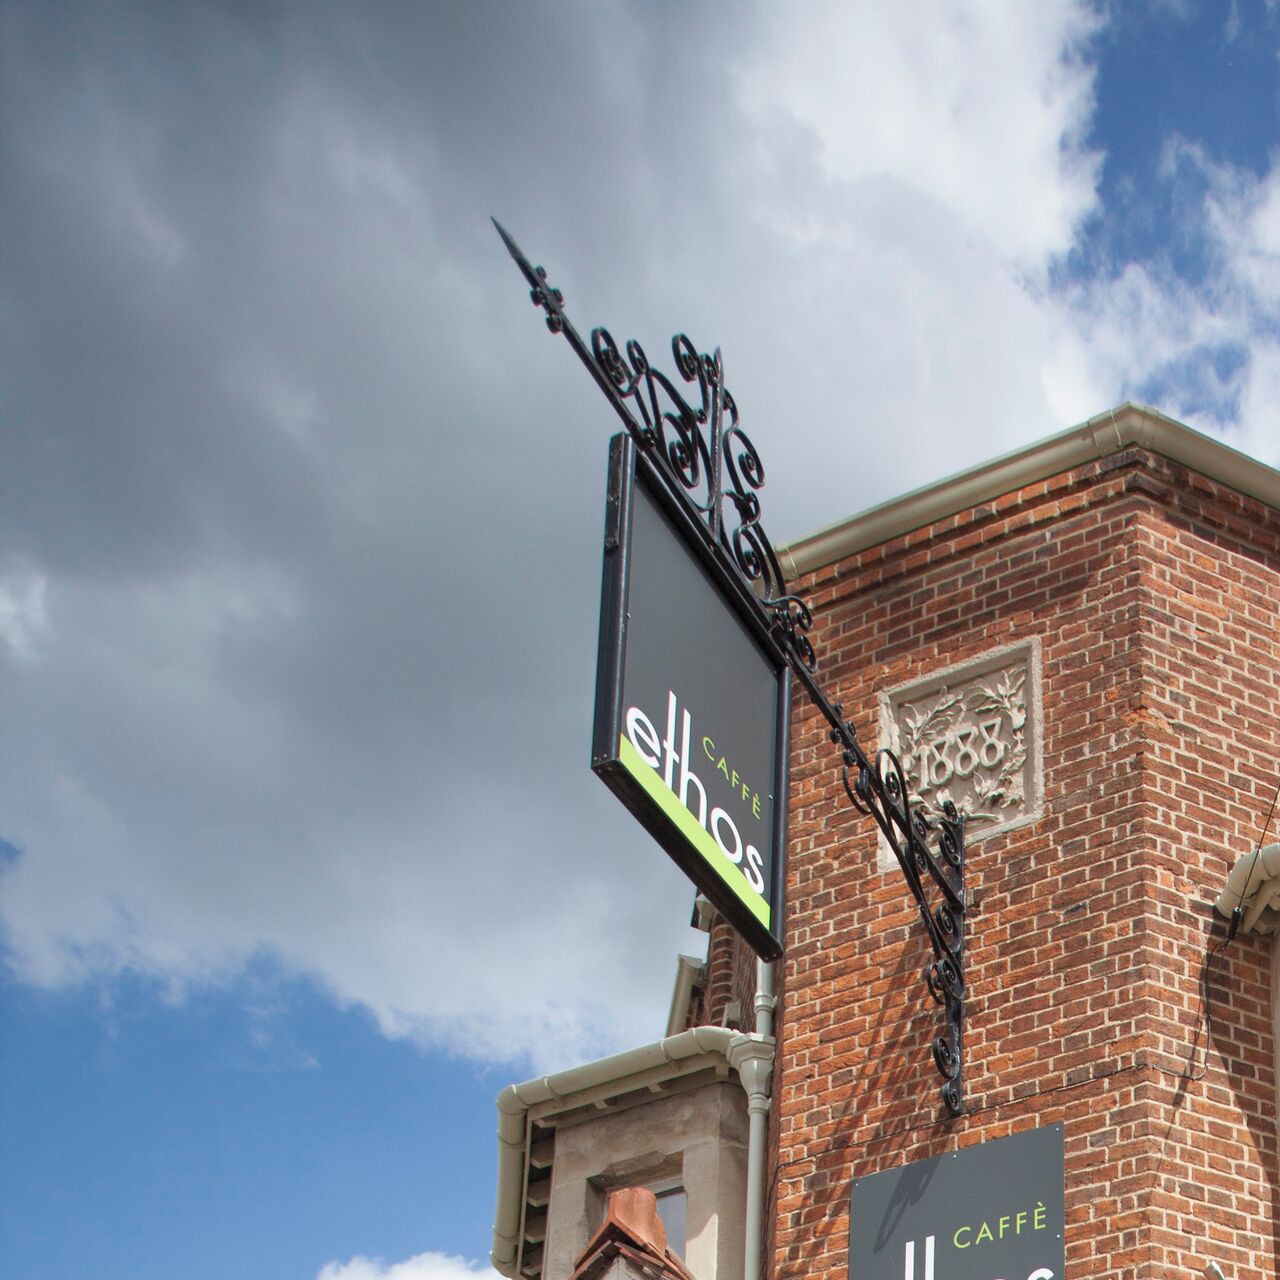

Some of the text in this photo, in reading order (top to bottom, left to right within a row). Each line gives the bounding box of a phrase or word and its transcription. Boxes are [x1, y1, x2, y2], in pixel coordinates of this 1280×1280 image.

[626, 690, 765, 895] ethos
[703, 736, 761, 820] CAFFÈ
[916, 717, 1005, 793] 1888
[952, 1201, 1048, 1249] CAFFÈ
